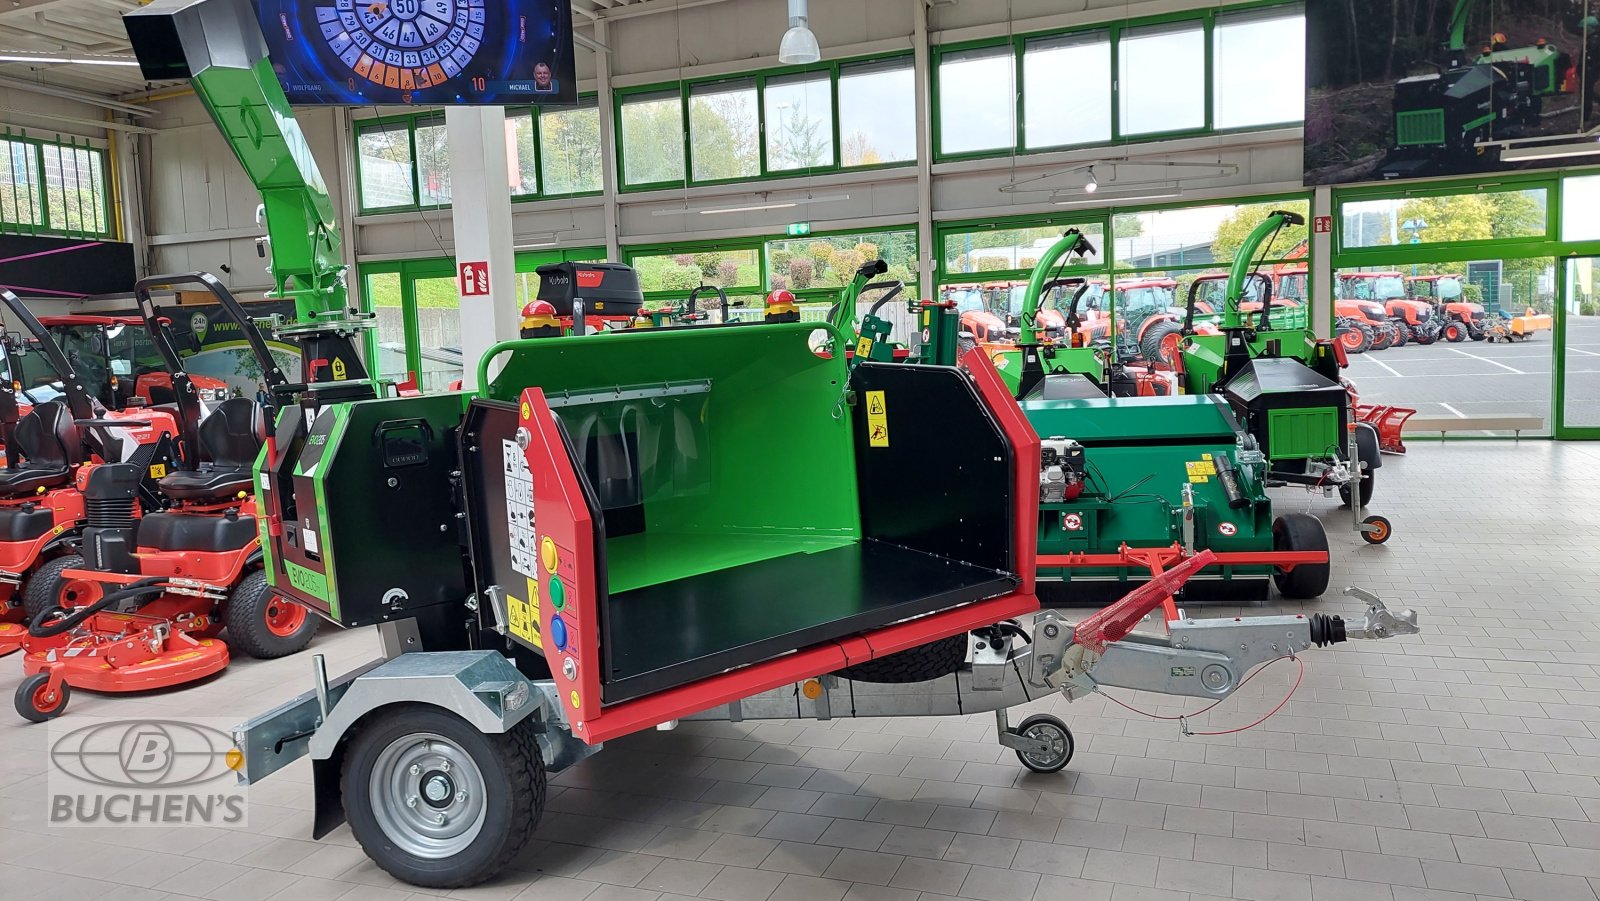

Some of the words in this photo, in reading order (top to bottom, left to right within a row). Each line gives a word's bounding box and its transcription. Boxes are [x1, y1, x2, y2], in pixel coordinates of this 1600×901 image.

[396, 0, 415, 14] 50
[436, 2, 448, 14] 49
[344, 15, 356, 26] 29
[364, 12, 378, 24] 45
[457, 12, 467, 24] 37
[475, 11, 482, 19] 15
[382, 26, 396, 40] 46
[425, 23, 439, 37] 48
[450, 29, 462, 41] 36
[473, 27, 481, 35] 14
[355, 32, 368, 44] 30
[403, 31, 416, 43] 47
[372, 45, 383, 55] 31
[438, 41, 451, 54] 35
[467, 41, 476, 49] 13
[389, 52, 400, 63] 32
[405, 54, 417, 64] 33
[423, 51, 436, 62] 34
[458, 54, 467, 62] 12
[447, 65, 456, 73] 11
[433, 72, 442, 80] 10
[471, 77, 486, 92] 10
[548, 275, 569, 285] Kubota
[193, 317, 206, 326] 24h
